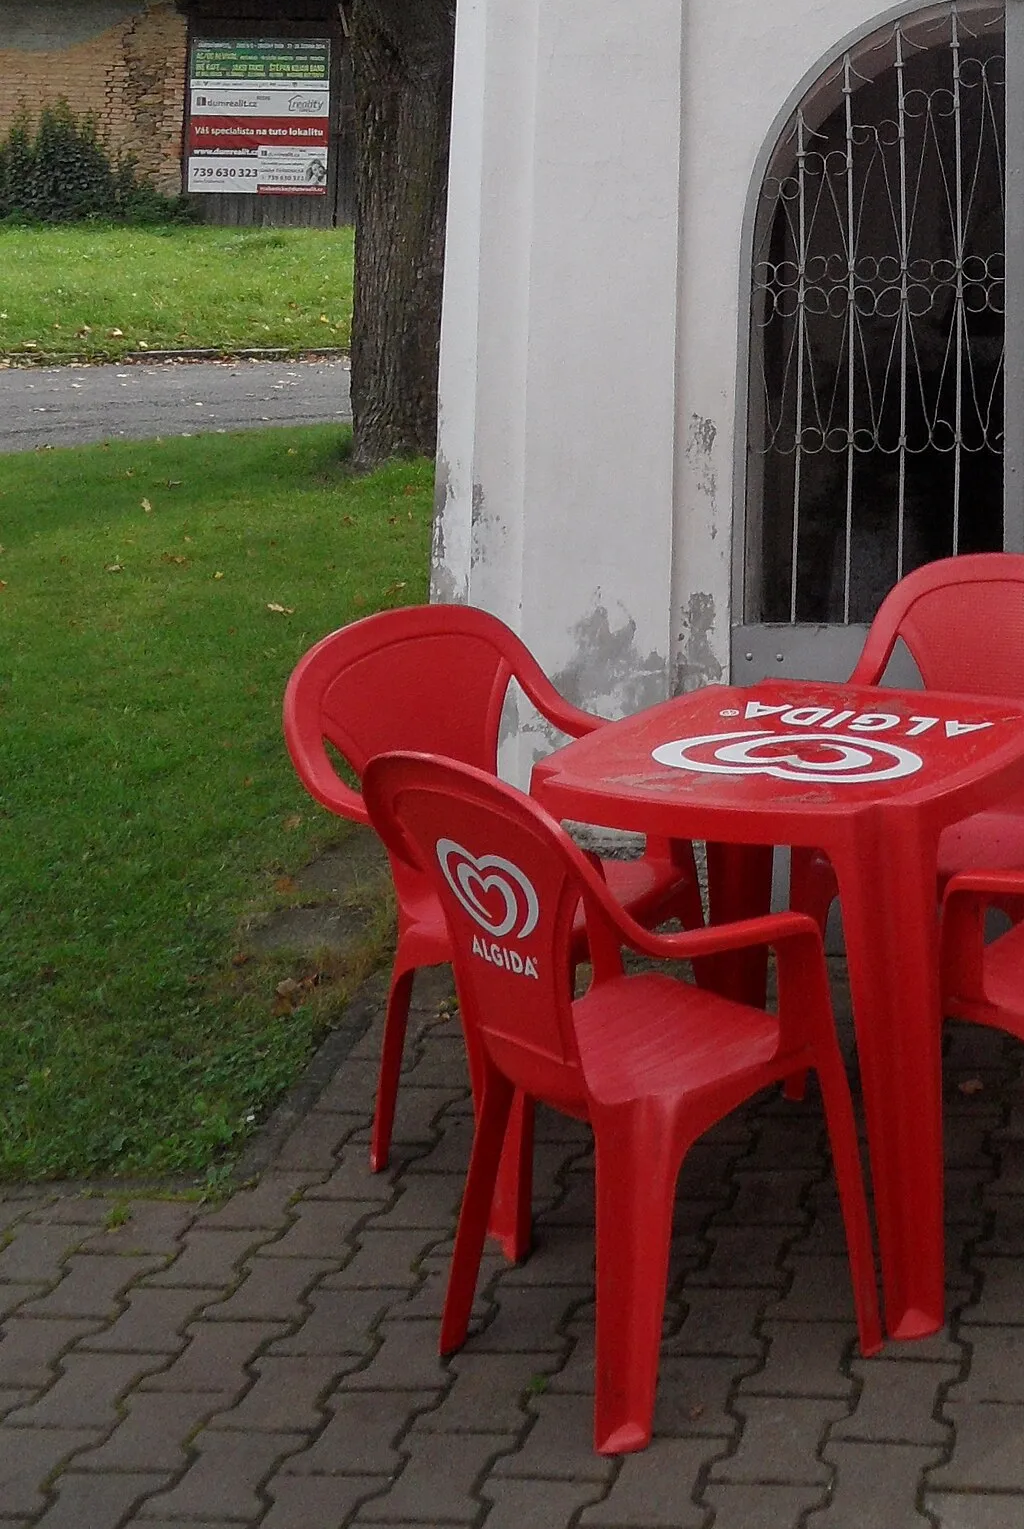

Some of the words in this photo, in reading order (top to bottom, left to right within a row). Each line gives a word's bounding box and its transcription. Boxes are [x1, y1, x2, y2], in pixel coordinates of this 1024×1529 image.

[207, 99, 258, 108] dumrealit.cz
[195, 126, 210, 135] Váš
[211, 126, 255, 136] specialista
[268, 128, 287, 136] tuto
[289, 127, 324, 136] lokalitu
[193, 168, 213, 177] 739
[216, 168, 236, 177] 630
[238, 168, 258, 178] 323
[744, 700, 994, 737] ALGIDA
[472, 934, 539, 979] ALGIDA
